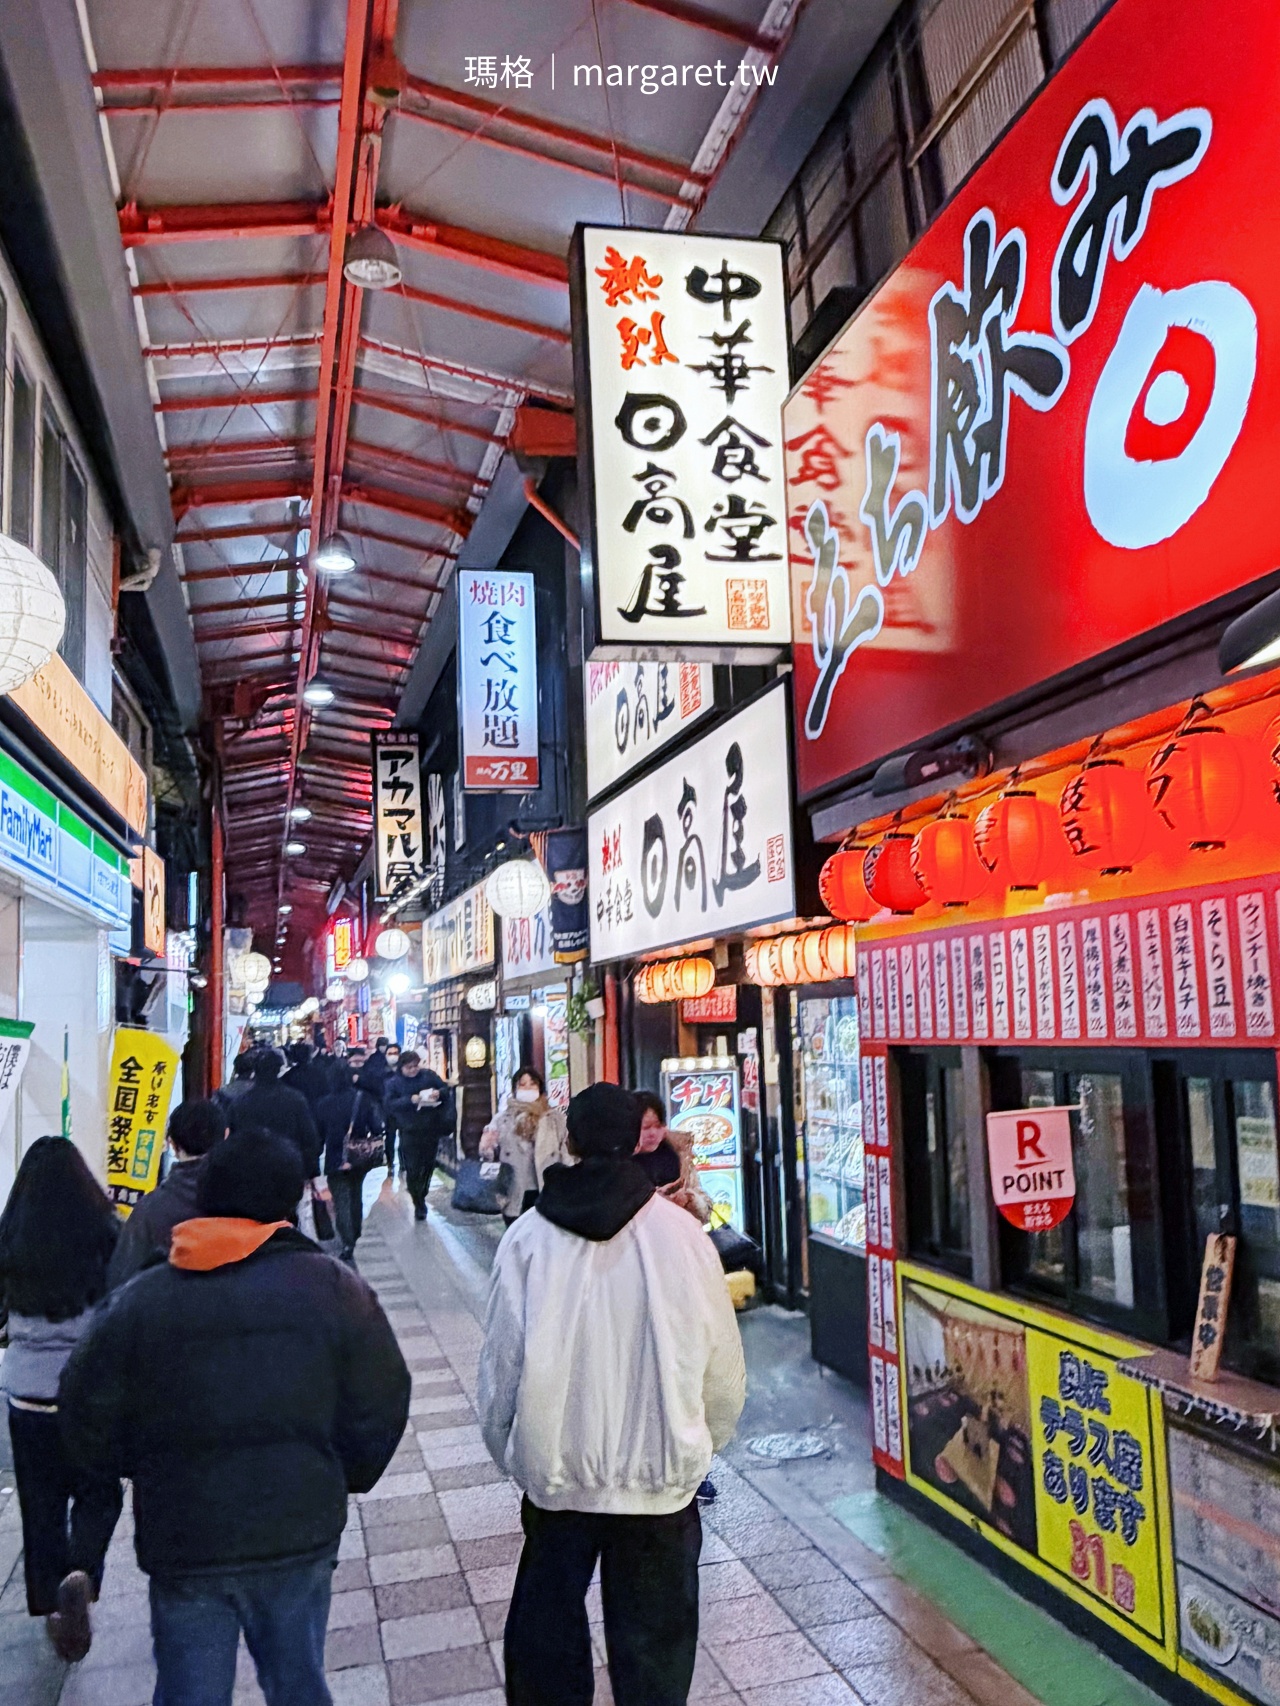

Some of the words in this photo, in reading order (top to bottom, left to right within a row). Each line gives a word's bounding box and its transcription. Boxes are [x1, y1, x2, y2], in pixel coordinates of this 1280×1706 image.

[595, 246, 680, 370] 熱烈
[685, 258, 783, 562] 中華食堂
[615, 391, 707, 623] 日高屋
[469, 579, 525, 607] 焼肉
[480, 610, 519, 748] 食べ放題
[490, 761, 528, 780] 万里
[1, 788, 53, 862] FamilyMart
[380, 750, 419, 892] アカマル屋
[641, 741, 761, 919] 日高屋
[597, 878, 633, 931] 中華食堂
[993, 941, 1005, 1017] コロッケ
[1173, 915, 1195, 1010] 白菜キムチ
[1207, 908, 1231, 1008] そら豆
[108, 1056, 144, 1174] 全国発送
[1016, 1120, 1047, 1160] R
[1002, 1170, 1065, 1195] POINT
[1043, 1449, 1145, 1546] あります
